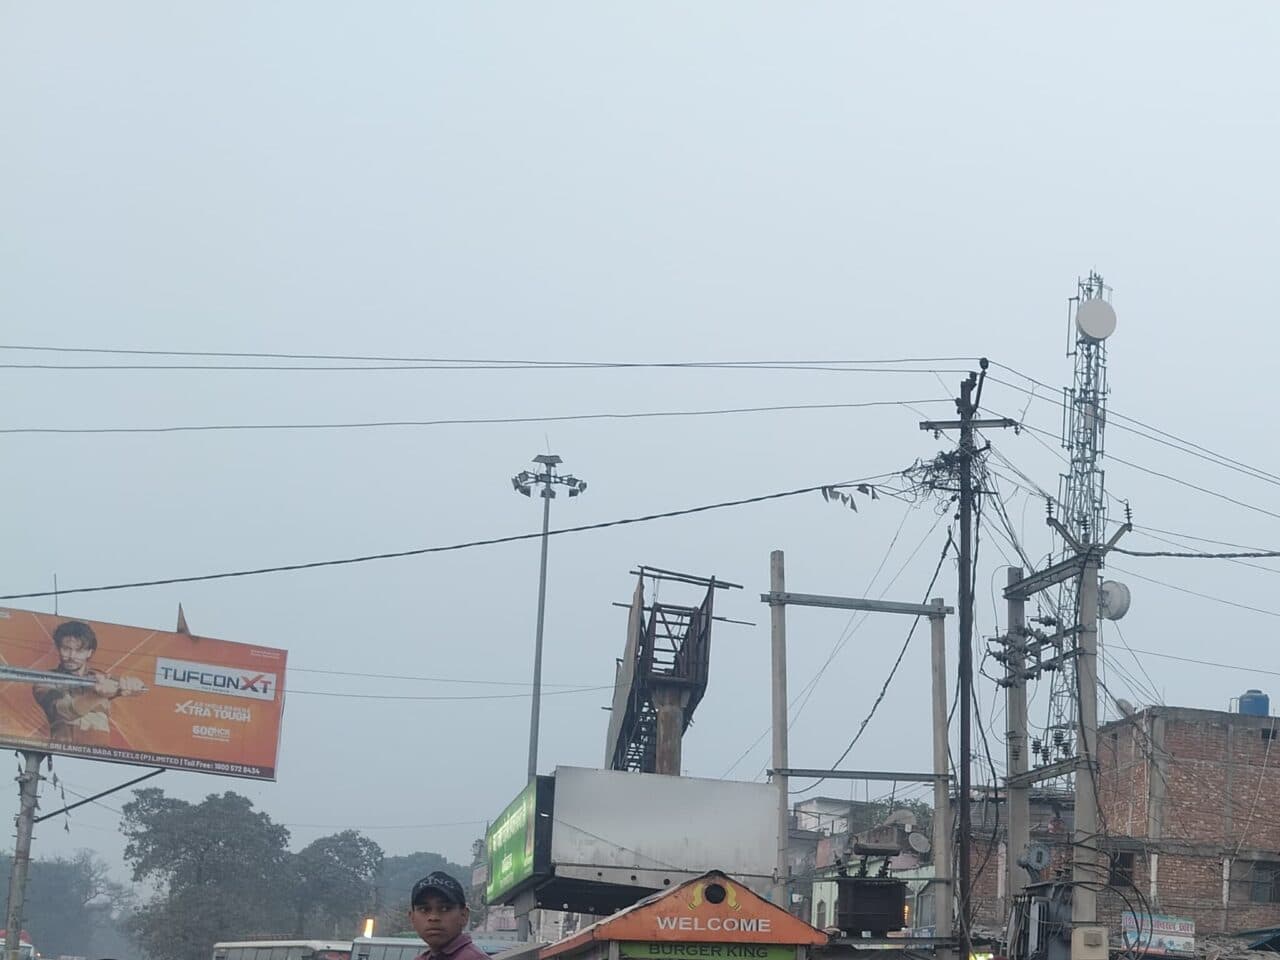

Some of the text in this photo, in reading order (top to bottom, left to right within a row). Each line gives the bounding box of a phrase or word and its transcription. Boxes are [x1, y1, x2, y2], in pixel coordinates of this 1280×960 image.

[214, 707, 251, 722] TOUGH
[656, 916, 771, 932] WELCOME
[649, 943, 768, 958] BURGER KING
